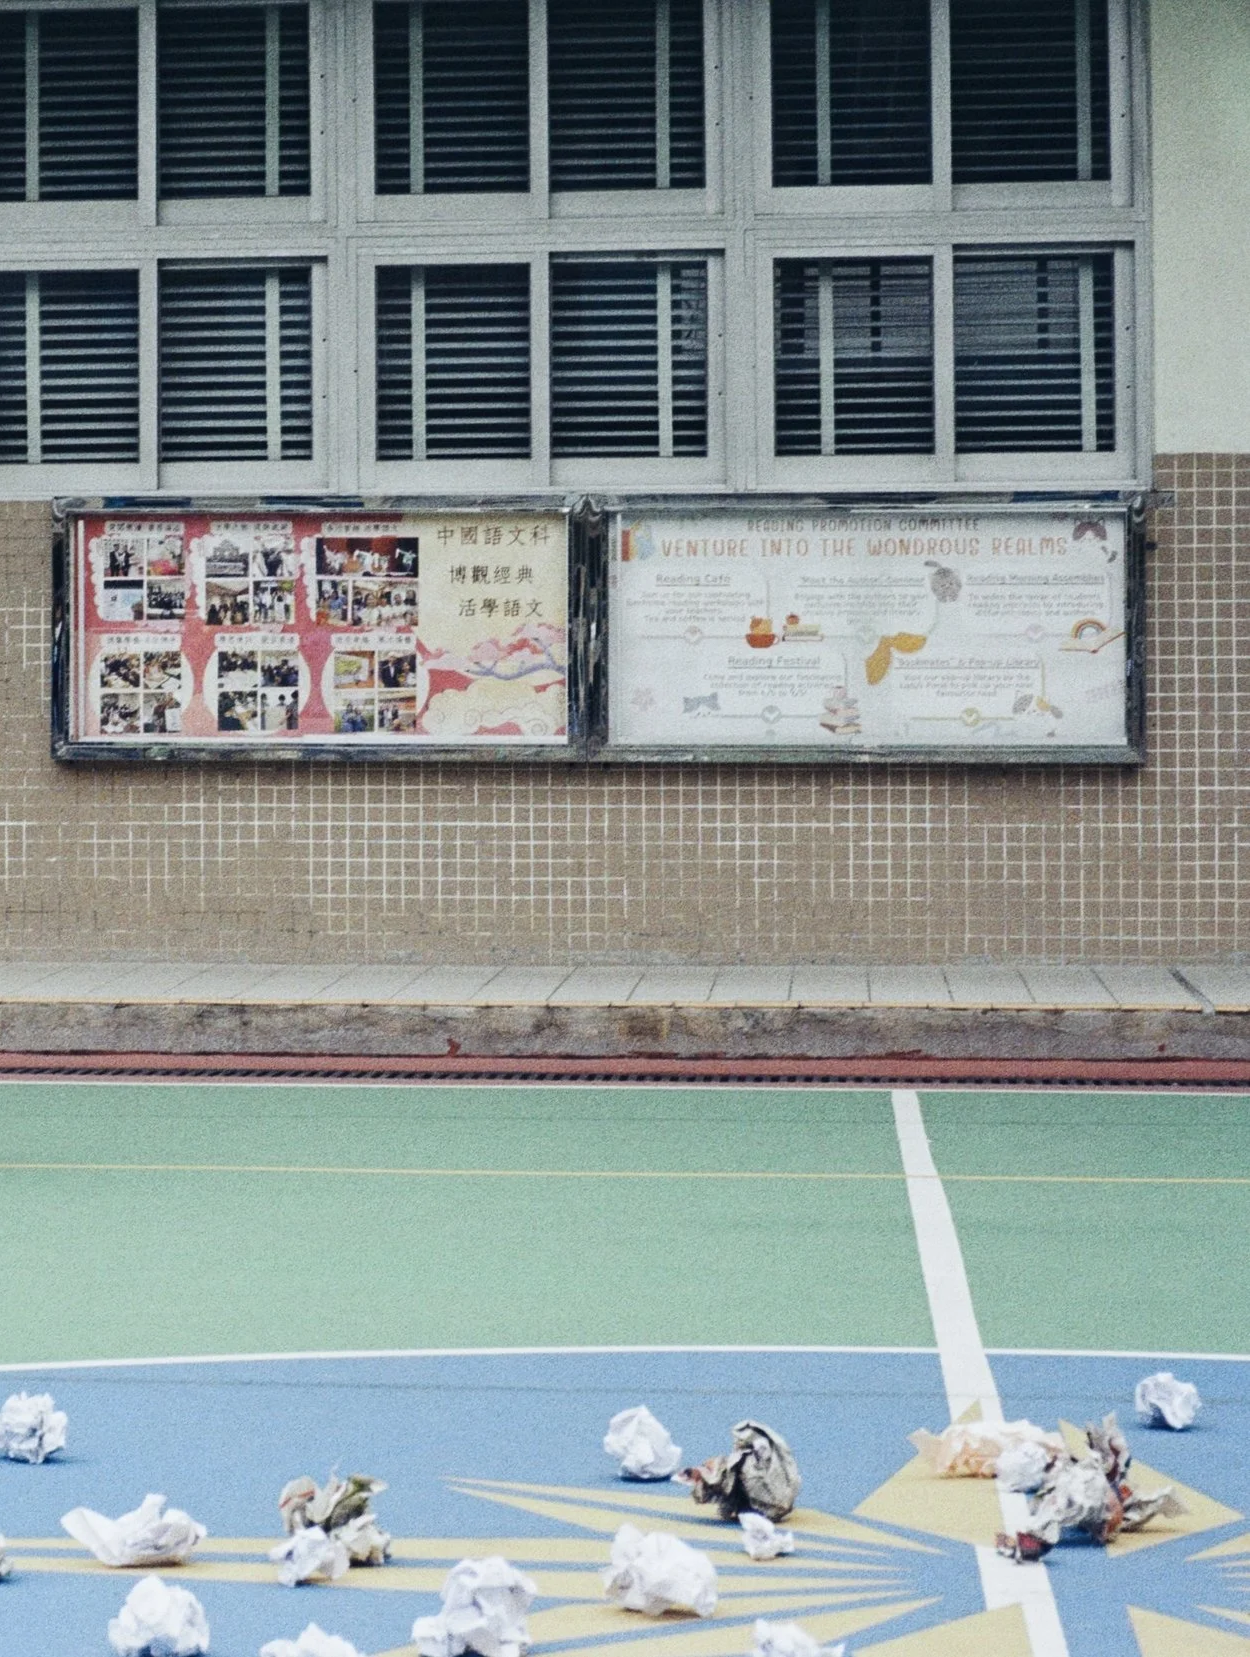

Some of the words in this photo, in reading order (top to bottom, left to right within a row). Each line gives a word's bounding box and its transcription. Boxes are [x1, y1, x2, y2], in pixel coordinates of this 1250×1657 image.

[437, 524, 551, 546] 中國語文科
[748, 519, 804, 532] READING
[812, 519, 891, 532] PROMOTION
[900, 518, 979, 531] COMMITTEE
[661, 538, 749, 557] VENTURE
[760, 538, 809, 557] INTO
[821, 538, 856, 557] THE
[867, 537, 980, 556] WONDROUS
[991, 536, 1068, 556] REALMS
[449, 564, 535, 585] 博觀經典
[656, 574, 700, 586] Reading
[458, 598, 543, 618] 活學語文
[727, 656, 773, 669] Reading
[777, 656, 821, 666] Festival
